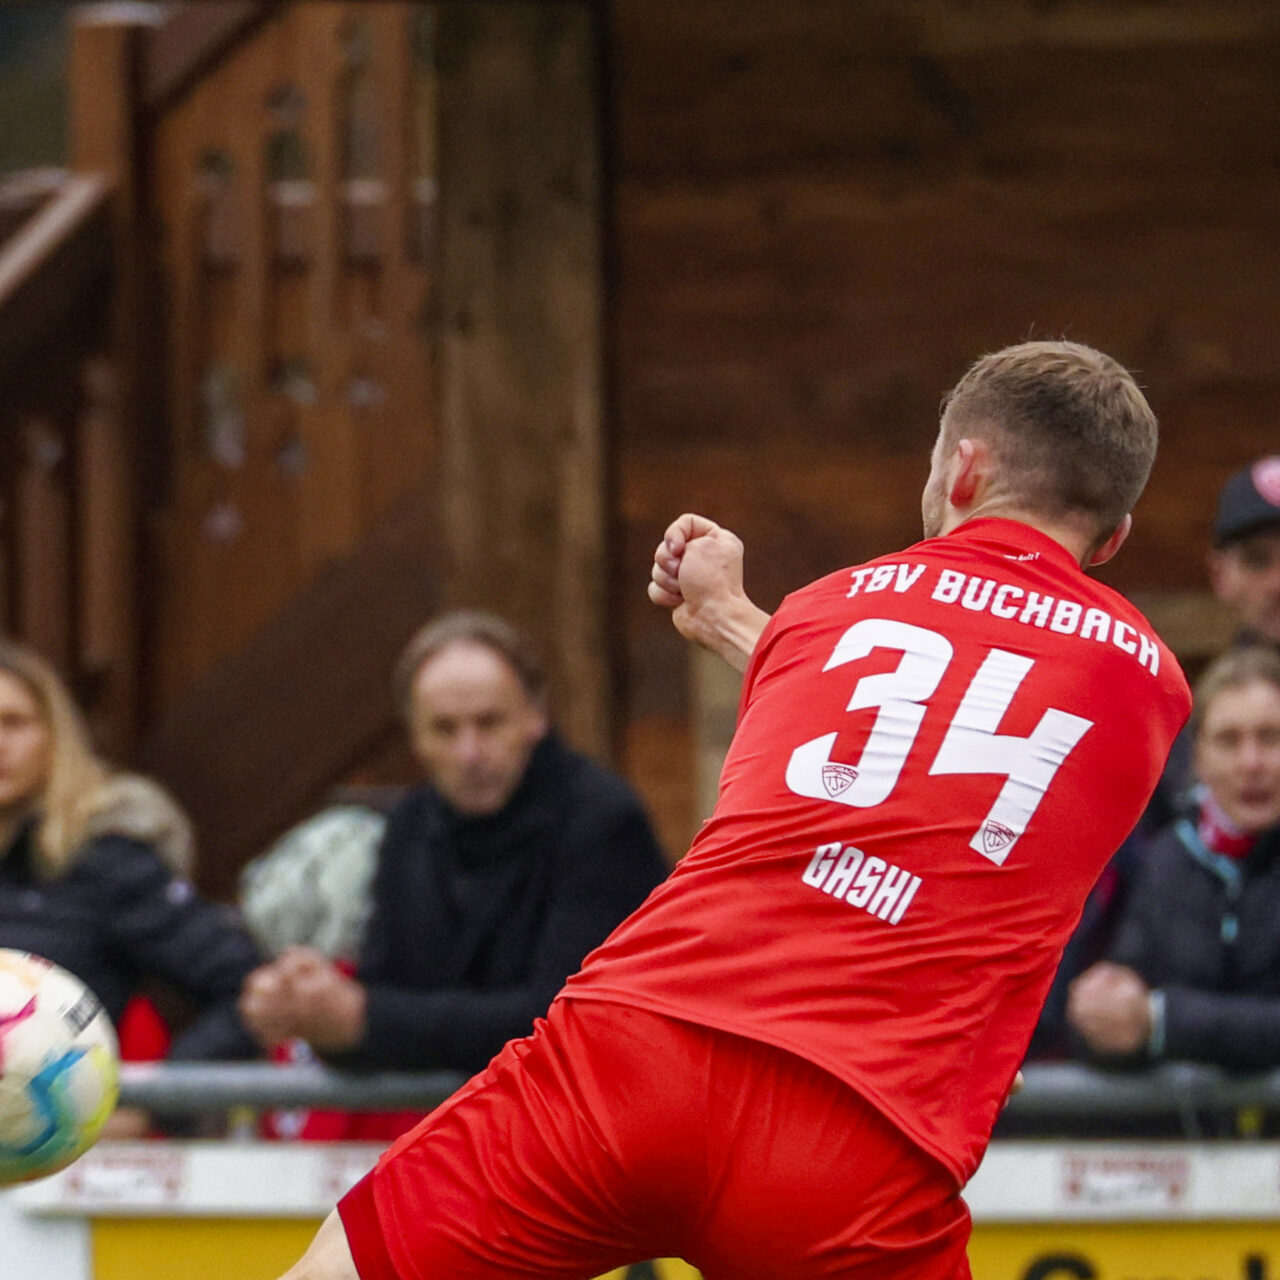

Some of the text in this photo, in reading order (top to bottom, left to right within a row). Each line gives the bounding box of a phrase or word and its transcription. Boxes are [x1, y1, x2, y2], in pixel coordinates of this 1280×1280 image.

[931, 569, 1160, 677] BUCHBACH
[785, 618, 1095, 867] 34
[801, 841, 922, 926] GASHI
